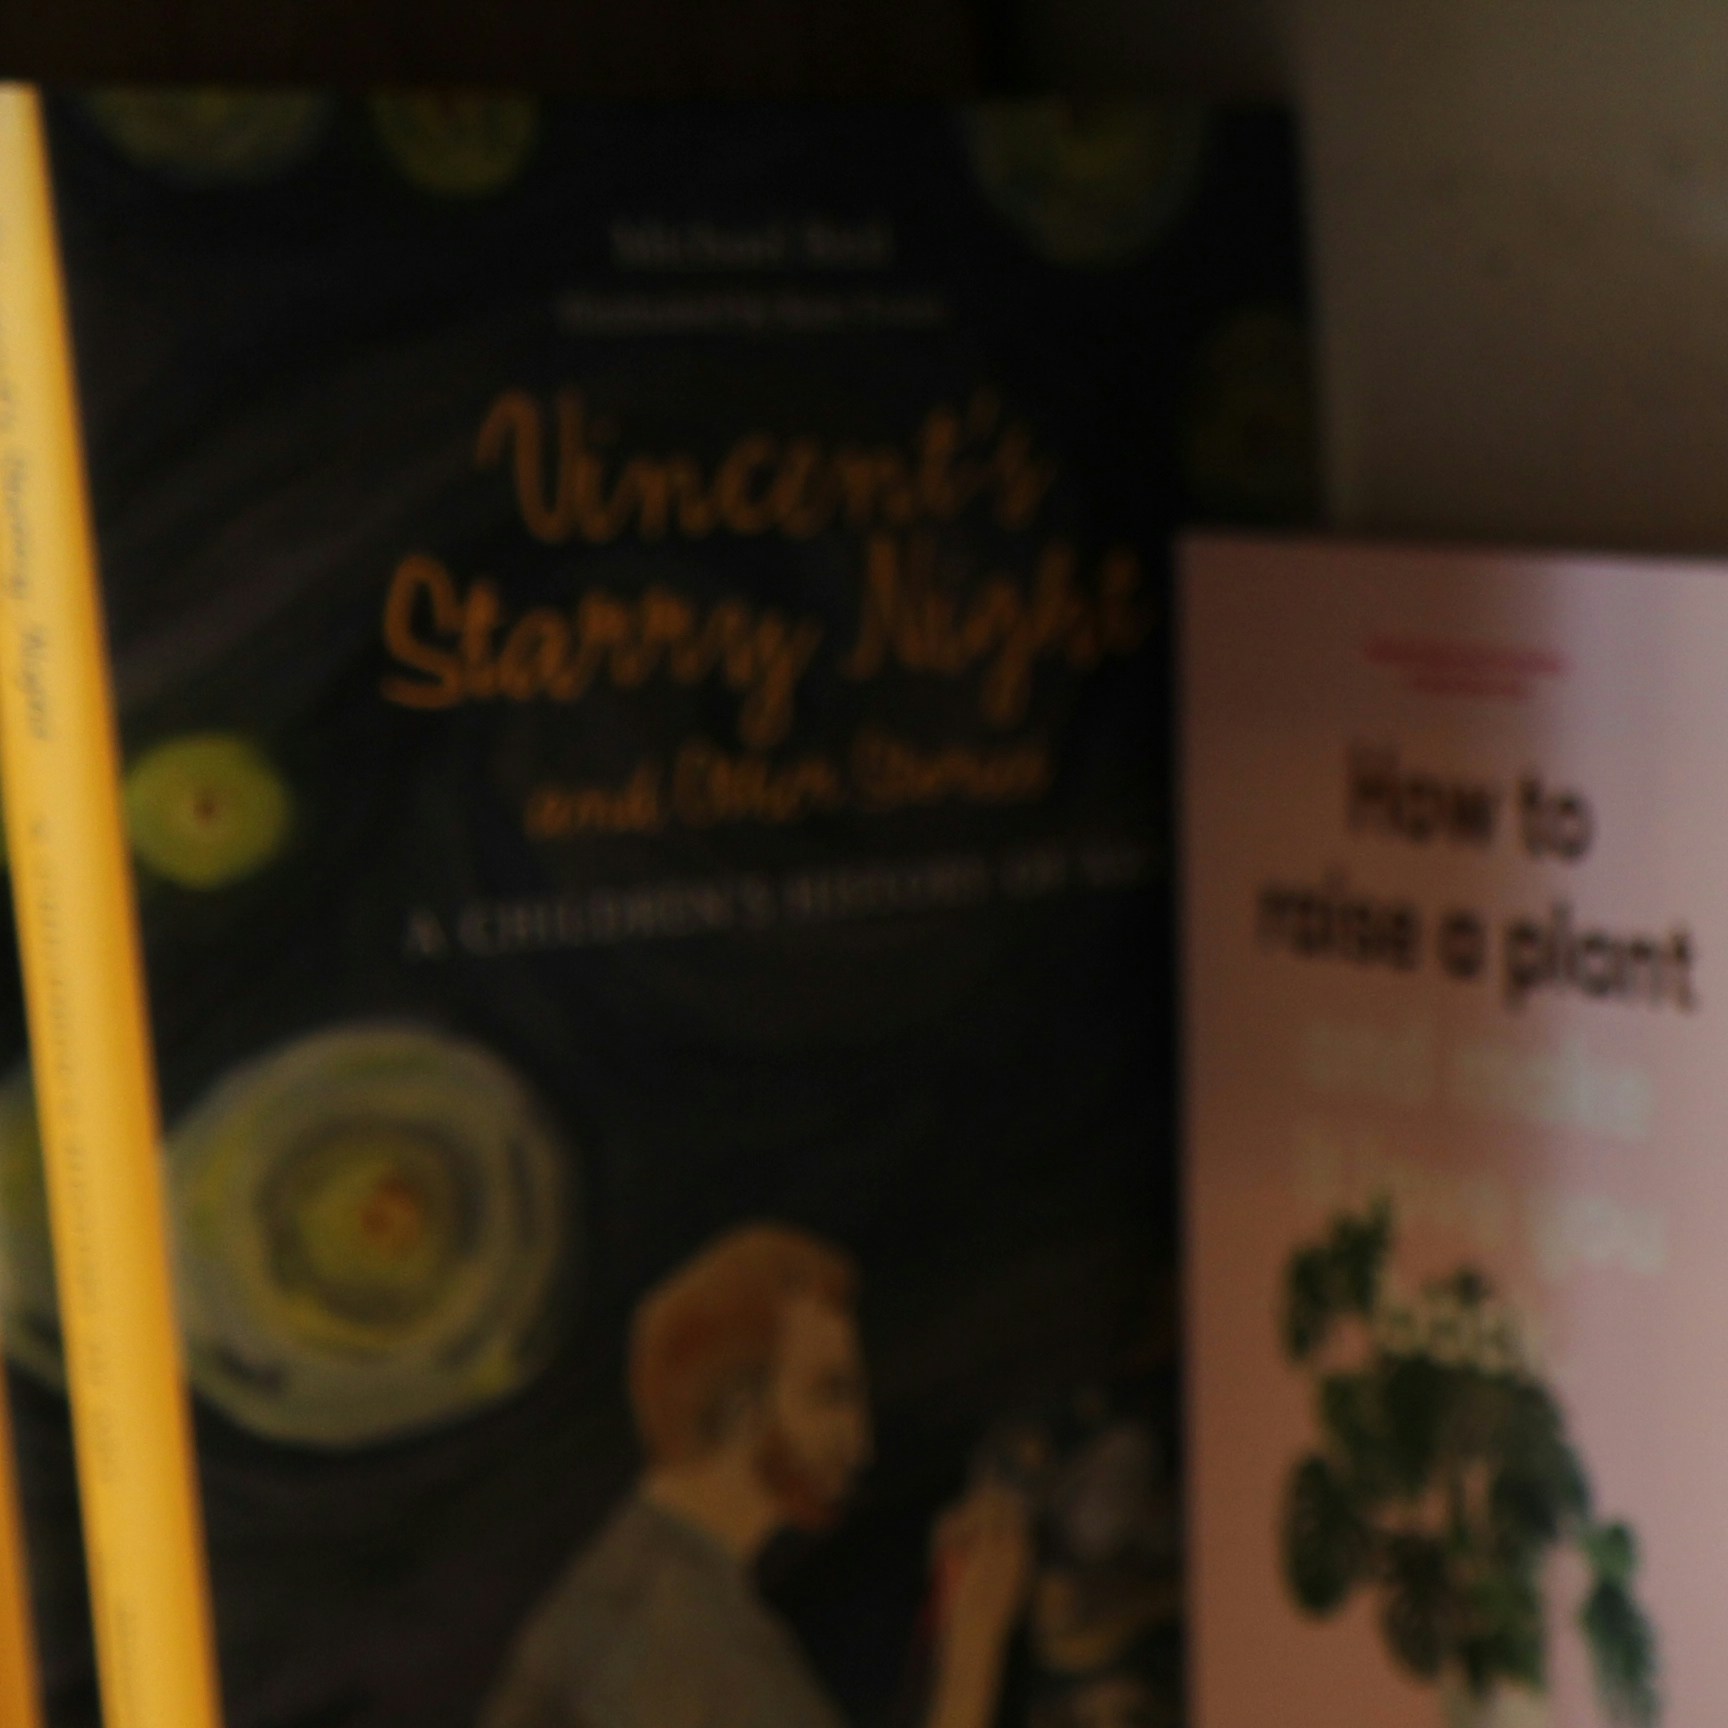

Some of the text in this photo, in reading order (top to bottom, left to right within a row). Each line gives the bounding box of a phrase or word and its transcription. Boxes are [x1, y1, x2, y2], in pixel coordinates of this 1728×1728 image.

[475, 385, 1059, 543] Vincent's
[380, 525, 1159, 750] Starry Night
[1345, 742, 1595, 862] How to
[1254, 873, 1696, 1012] raise a plant
